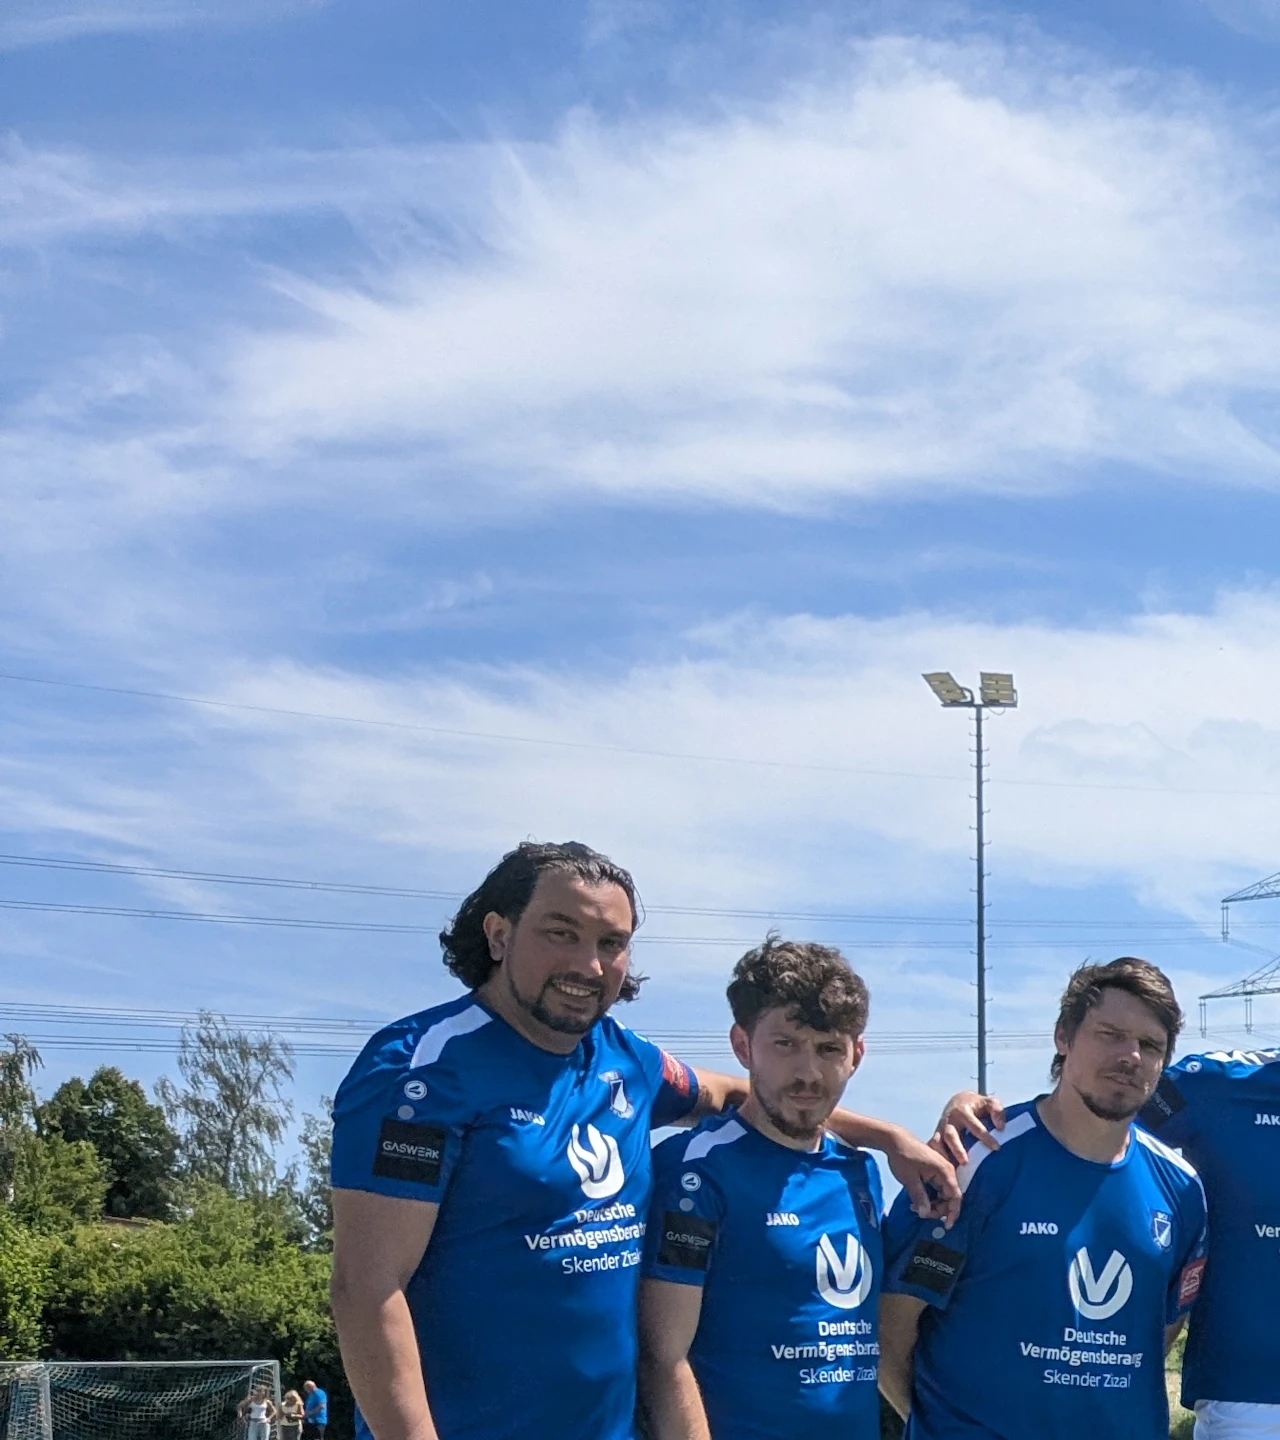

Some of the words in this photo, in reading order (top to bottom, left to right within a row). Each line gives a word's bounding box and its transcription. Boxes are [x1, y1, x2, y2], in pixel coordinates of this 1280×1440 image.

[510, 1107, 545, 1126] JAKO
[574, 1203, 636, 1224] Deutsche
[766, 1211, 800, 1226] JAKO
[1019, 1221, 1059, 1235] JAKO
[562, 1253, 620, 1275] Skender
[818, 1319, 872, 1337] Deutsche
[1064, 1327, 1127, 1346] Deutsche
[799, 1367, 856, 1384] Skender
[1043, 1369, 1102, 1388] Skender
